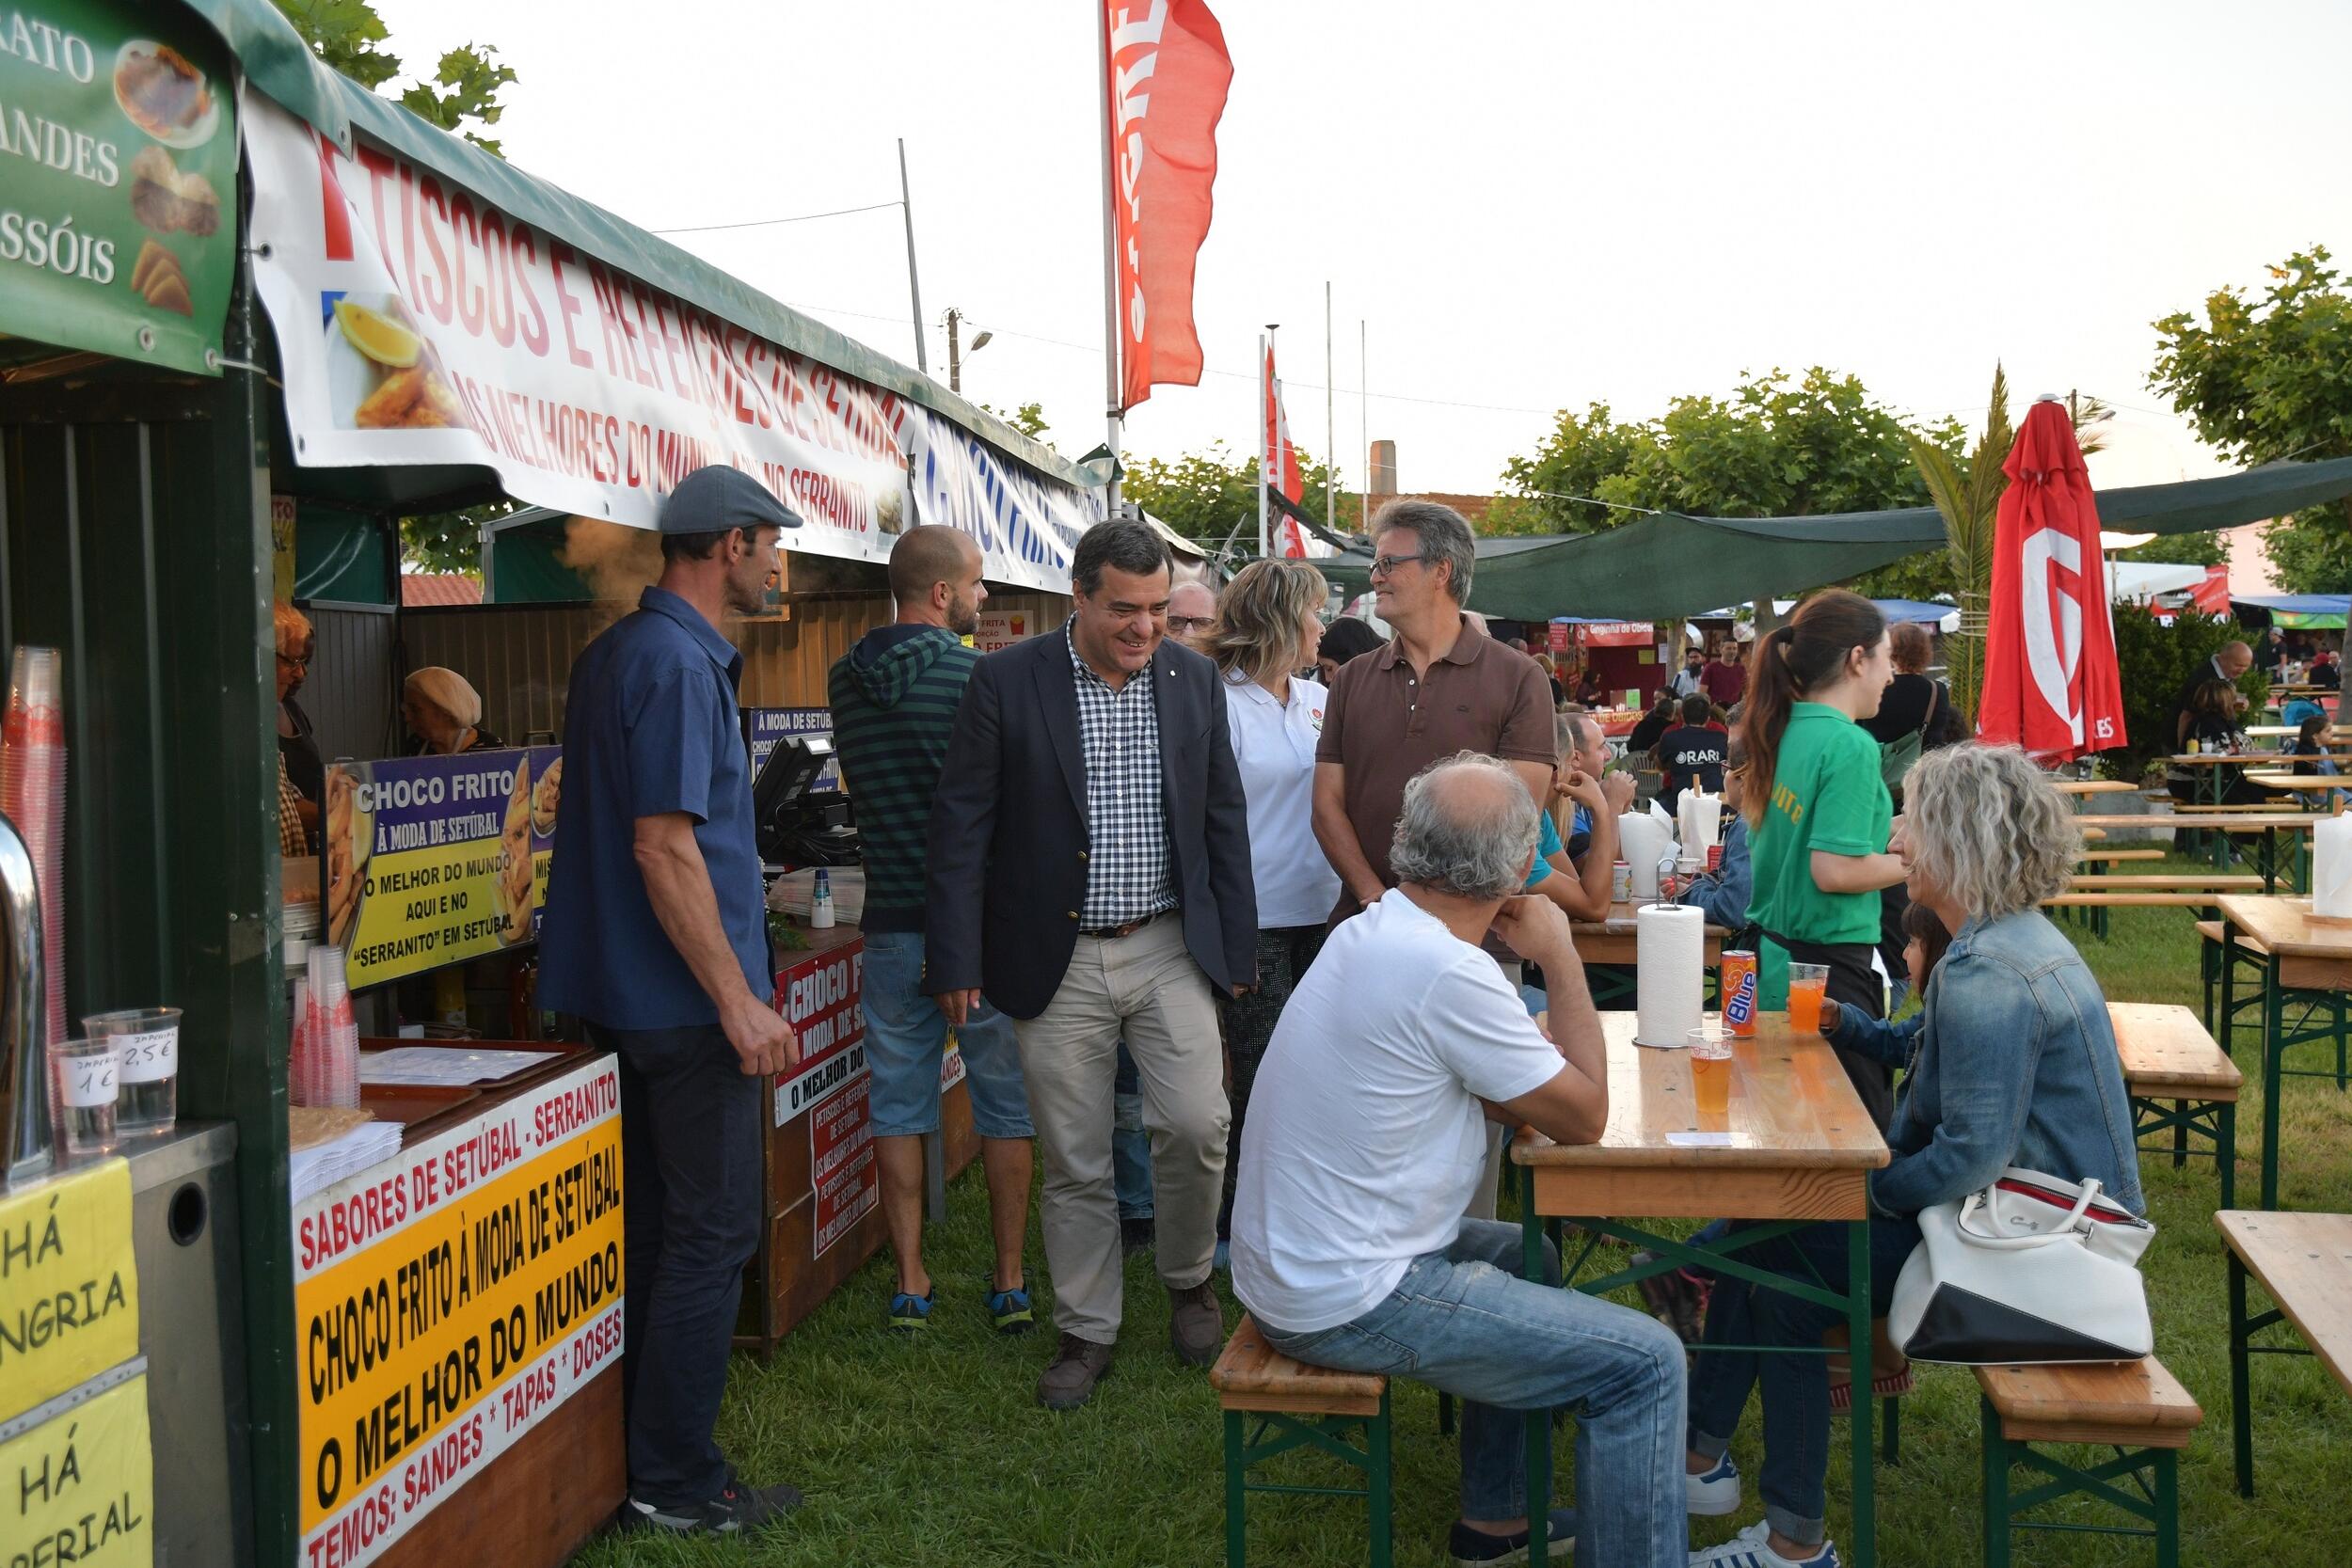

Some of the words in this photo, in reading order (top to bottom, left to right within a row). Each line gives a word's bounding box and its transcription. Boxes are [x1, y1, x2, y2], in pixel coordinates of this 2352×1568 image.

[549, 239, 595, 370] E
[485, 384, 619, 486] MELHORES
[628, 420, 651, 489] DO
[658, 429, 724, 494] MUN
[790, 467, 866, 533] SERRANITO
[981, 619, 1006, 627] FRITA
[753, 740, 771, 752] CHOCO
[767, 714, 791, 731] MODA
[793, 713, 804, 730] DE
[356, 776, 445, 814] CHOCO
[452, 769, 515, 802] FRITO
[377, 822, 388, 852] À
[390, 821, 428, 849] MODA
[430, 818, 446, 845] DE
[448, 811, 500, 841] SETÚBAL
[364, 877, 375, 897] O
[380, 867, 440, 895] MELHOR
[444, 862, 463, 883] DO
[467, 853, 512, 879] MUNDO
[406, 899, 437, 922] AQUI
[440, 896, 448, 914] E
[451, 892, 468, 911] NO
[443, 924, 461, 947] EM
[464, 913, 515, 942] SETÚBAL
[790, 958, 848, 1024] CHOCO
[1726, 972, 1756, 1023] Blue
[803, 1016, 835, 1061] MODA
[837, 1006, 851, 1040] DE
[791, 1085, 800, 1110] O
[803, 1055, 847, 1103] MELHOR
[850, 1045, 864, 1076] DO
[300, 1173, 407, 1271] SABORES
[413, 1157, 438, 1213] DE
[444, 1121, 521, 1196] SETÚBAL
[534, 1070, 617, 1148] SERRANITO
[2, 1195, 63, 1277] HÁ
[309, 1275, 390, 1405] CHOCO
[397, 1239, 453, 1350] FRITO
[459, 1210, 470, 1308] À
[476, 1196, 525, 1296] MODA
[529, 1180, 550, 1260] DE
[555, 1140, 620, 1243] SETÚBAL
[317, 1437, 342, 1510] O
[356, 1335, 483, 1486] MELHOR
[491, 1304, 526, 1380] DO
[536, 1241, 618, 1347] MUNDO
[309, 1484, 397, 1568] TEMOS:
[404, 1413, 483, 1513] SANDES
[503, 1357, 556, 1433] TAPAS
[574, 1307, 621, 1380] DOSES
[21, 1422, 81, 1515] HÁ
